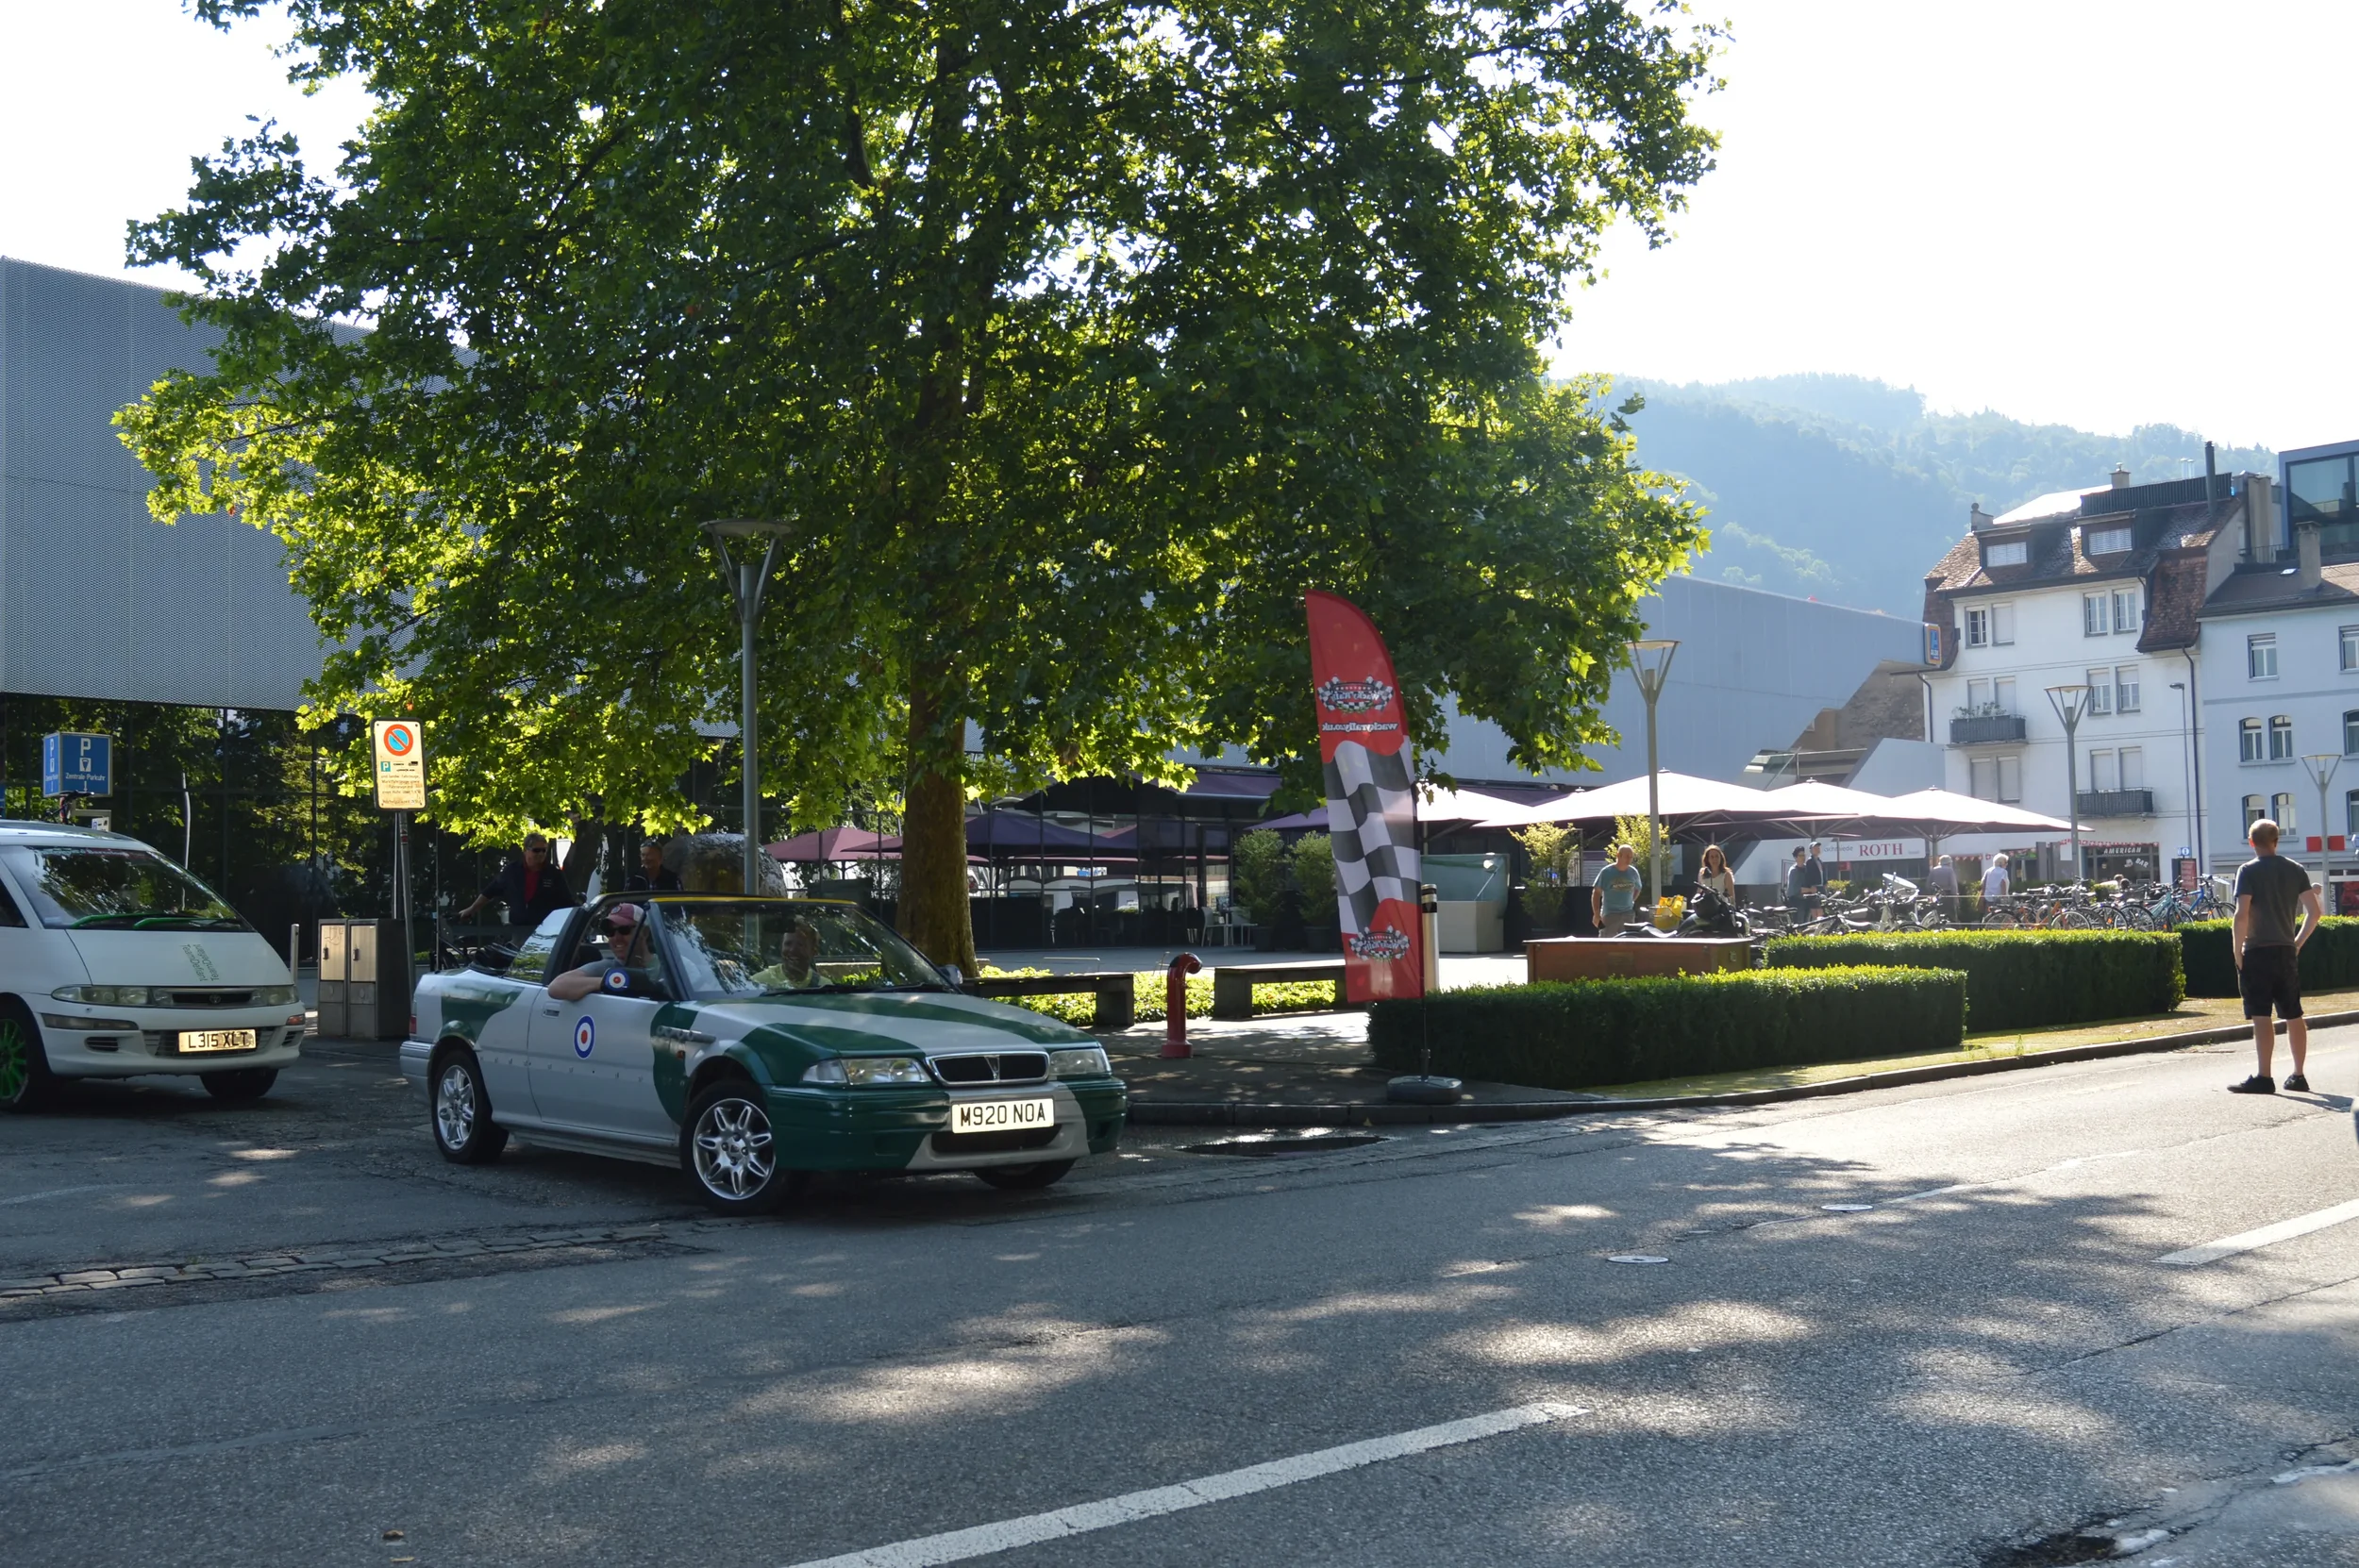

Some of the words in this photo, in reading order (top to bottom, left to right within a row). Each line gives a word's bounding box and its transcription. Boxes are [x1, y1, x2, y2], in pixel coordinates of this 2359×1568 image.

[80, 737, 92, 757] P
[65, 772, 86, 781] Zentrale
[86, 774, 106, 782] Parkuhr
[1859, 842, 1903, 857] ROTH
[2103, 846, 2142, 855] AMERICAN
[2134, 858, 2150, 869] BAR
[188, 1032, 219, 1048] L315
[223, 1030, 248, 1047] XLT
[960, 1105, 1007, 1127] M920
[1012, 1102, 1046, 1124] NOA
